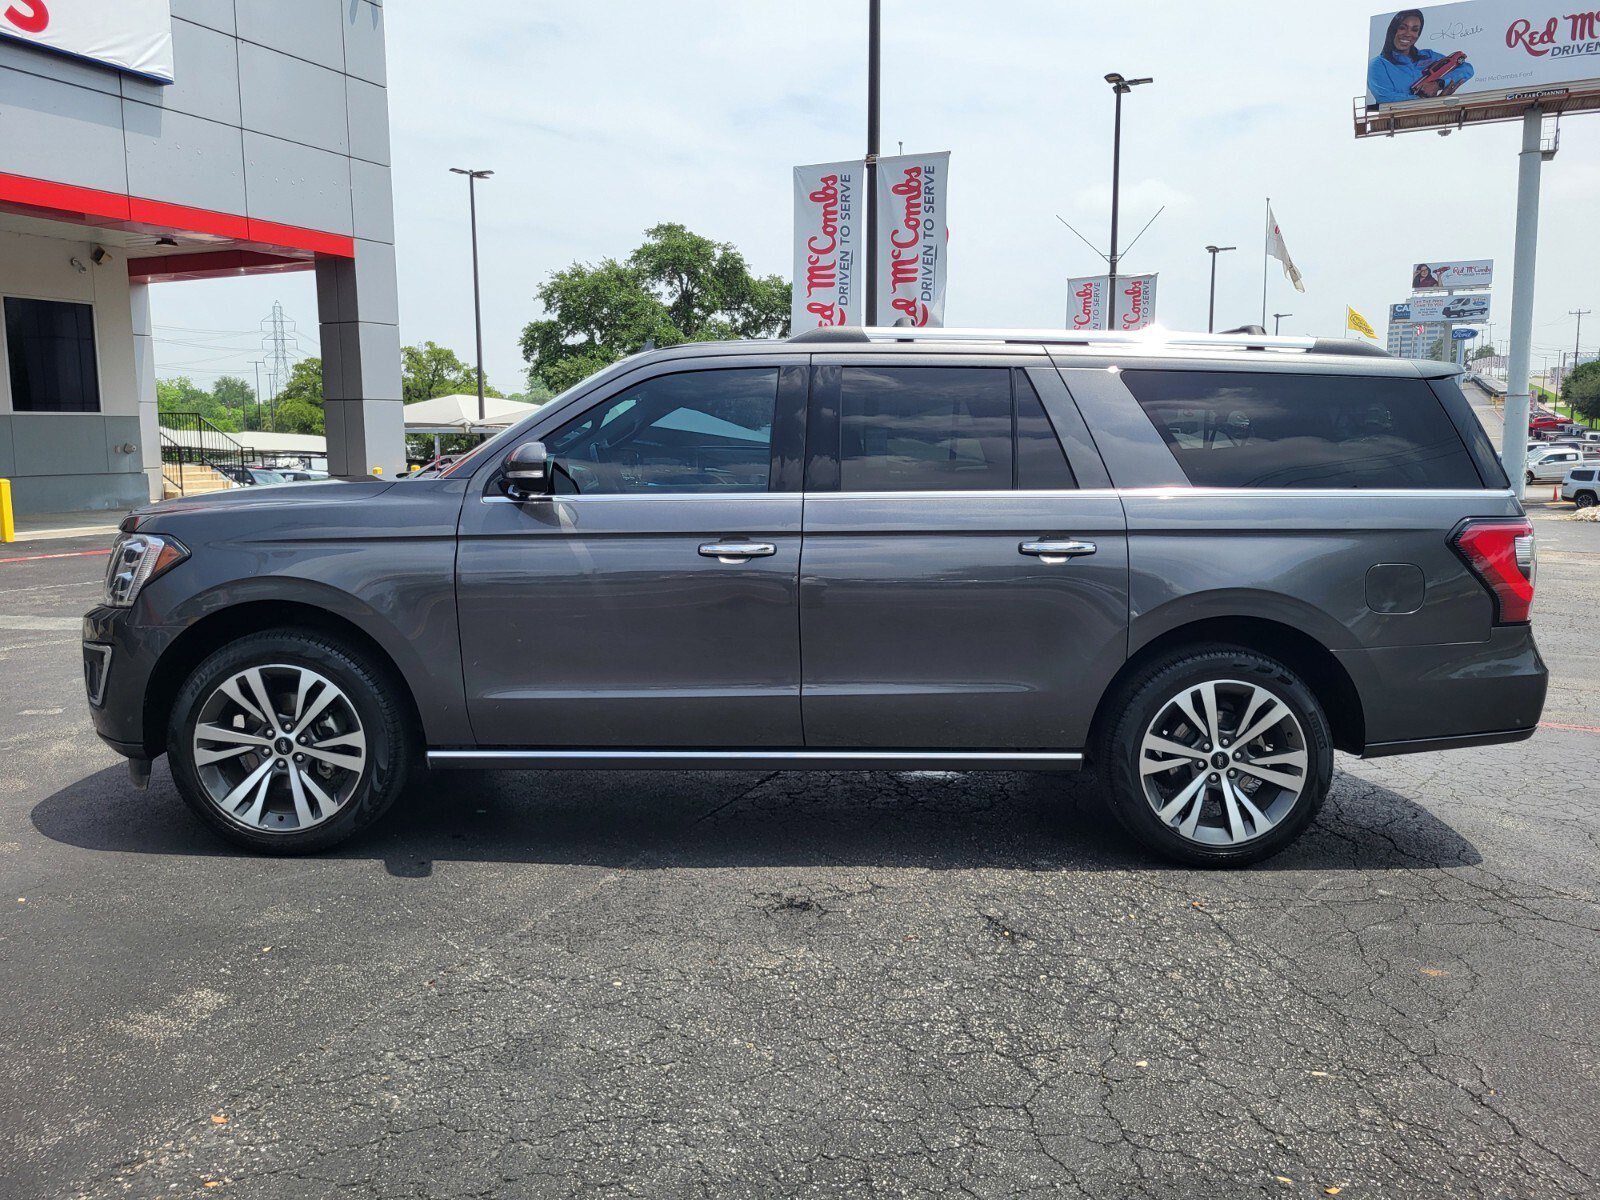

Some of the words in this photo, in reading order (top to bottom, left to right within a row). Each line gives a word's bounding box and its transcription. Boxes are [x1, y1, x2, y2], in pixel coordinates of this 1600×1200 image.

[1505, 17, 1559, 57] Red
[1488, 72, 1518, 81] McCombs
[840, 174, 851, 221] SERVE
[923, 165, 935, 214] SERVE
[806, 174, 839, 298] McCombs
[839, 225, 851, 246] TO
[890, 166, 922, 294] McCombs
[922, 218, 935, 240] TO
[838, 250, 851, 306] DRIVEN
[920, 244, 934, 302] DRIVEN
[1142, 280, 1150, 305] SERVE
[1092, 310, 1100, 320] TO
[1142, 307, 1150, 319] TO
[1453, 330, 1471, 338] Ford
